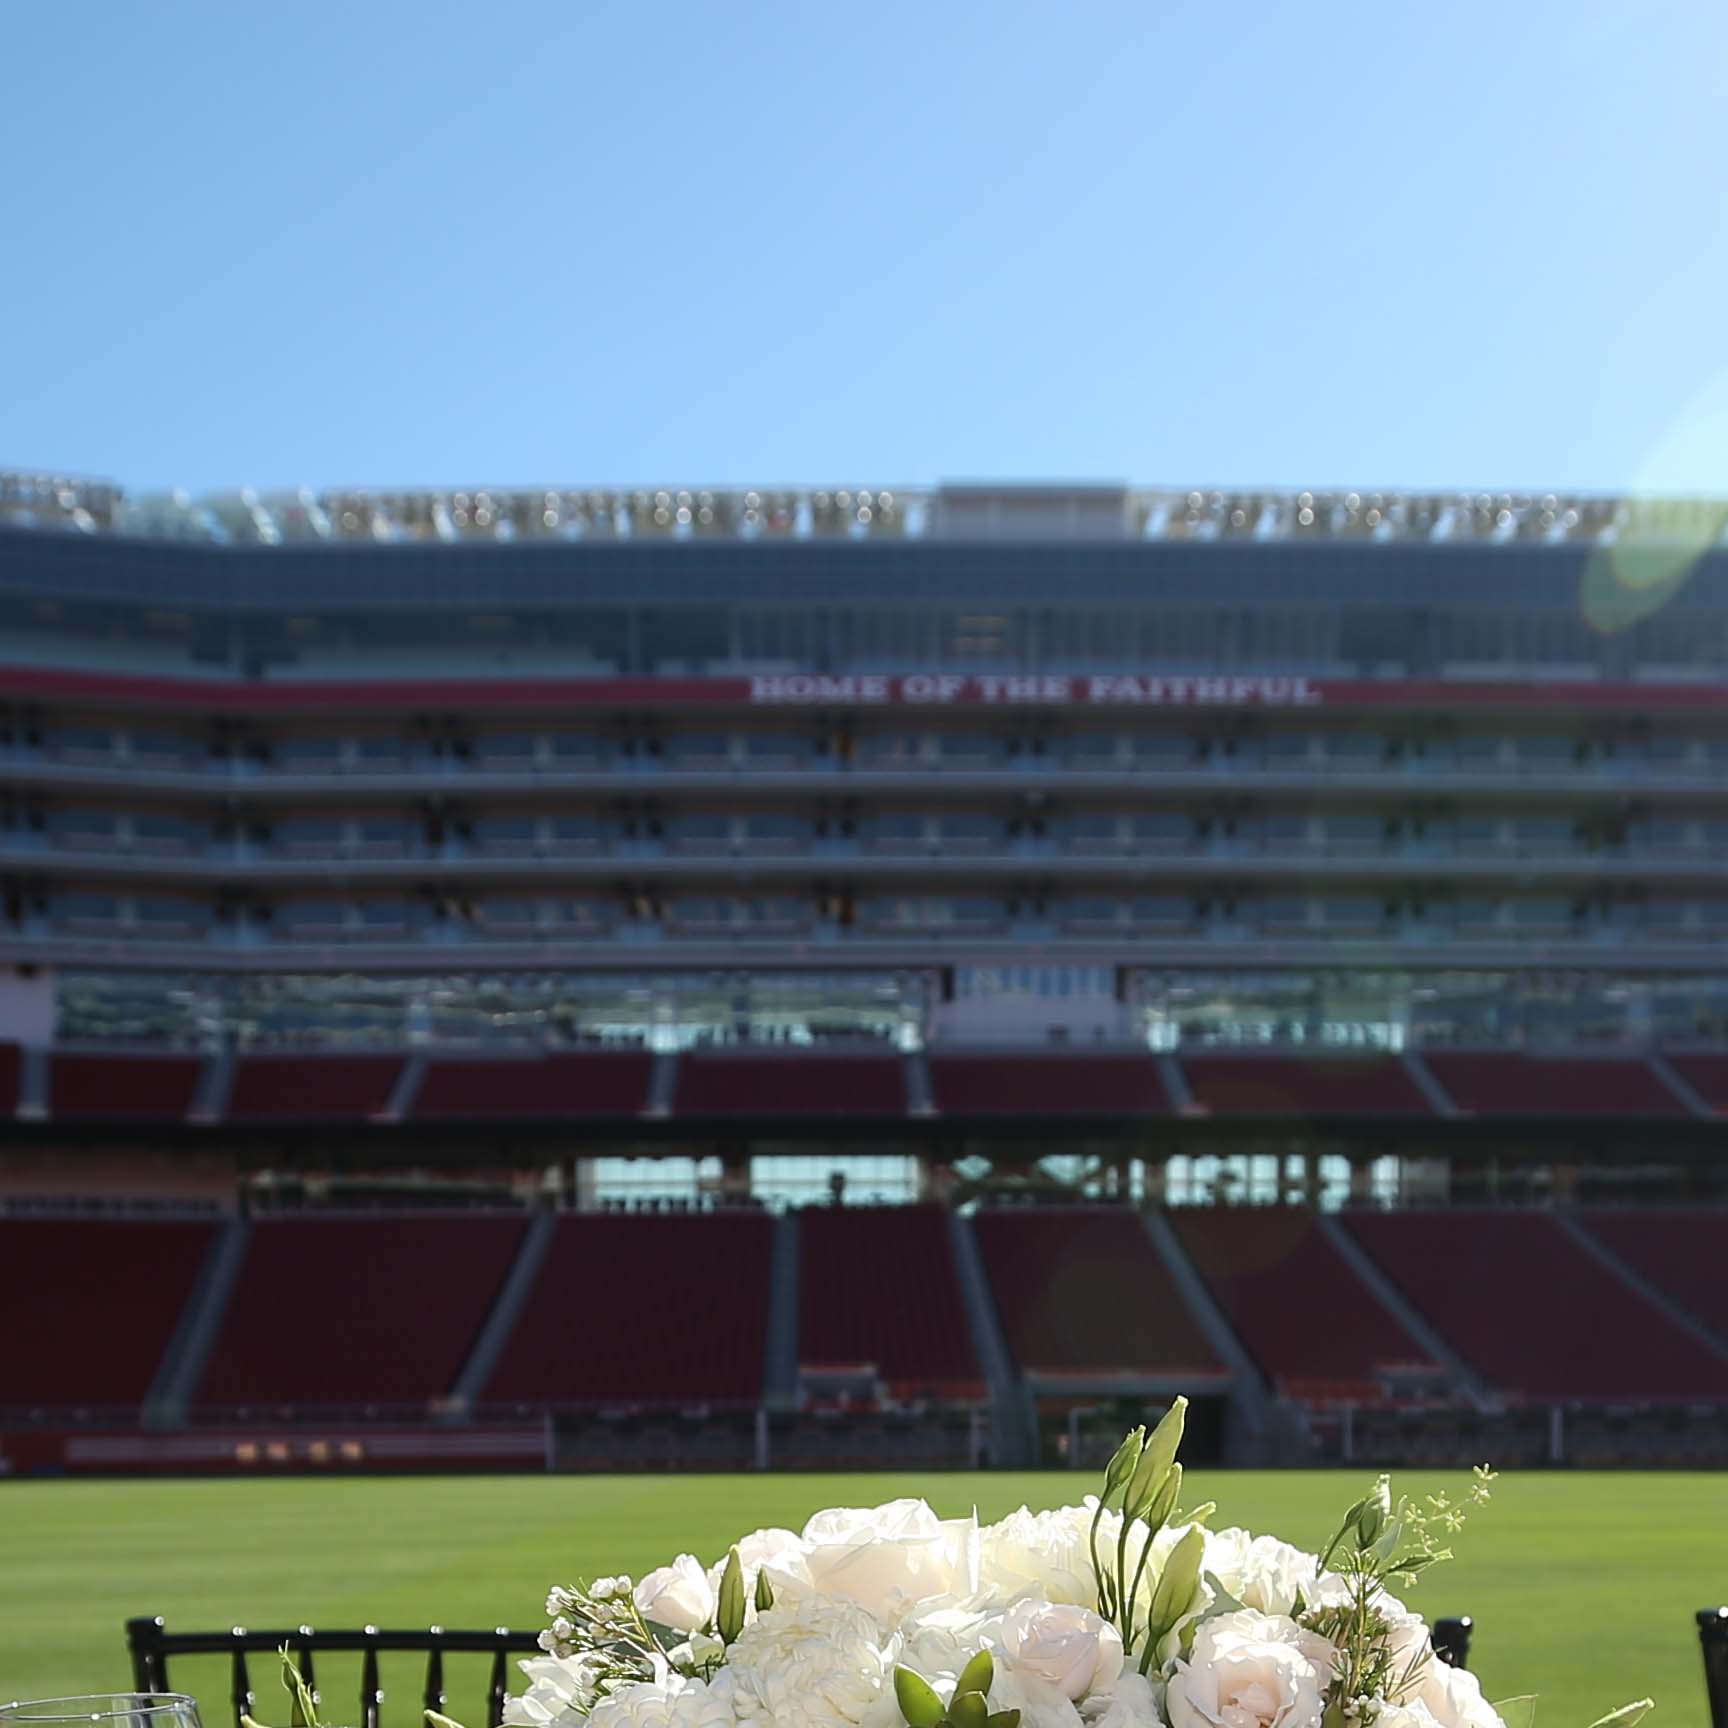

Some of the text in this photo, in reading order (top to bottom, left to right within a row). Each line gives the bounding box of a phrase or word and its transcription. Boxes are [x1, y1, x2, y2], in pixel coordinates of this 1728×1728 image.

[751, 675, 1323, 703] HOME OF THE FAITHFUL
